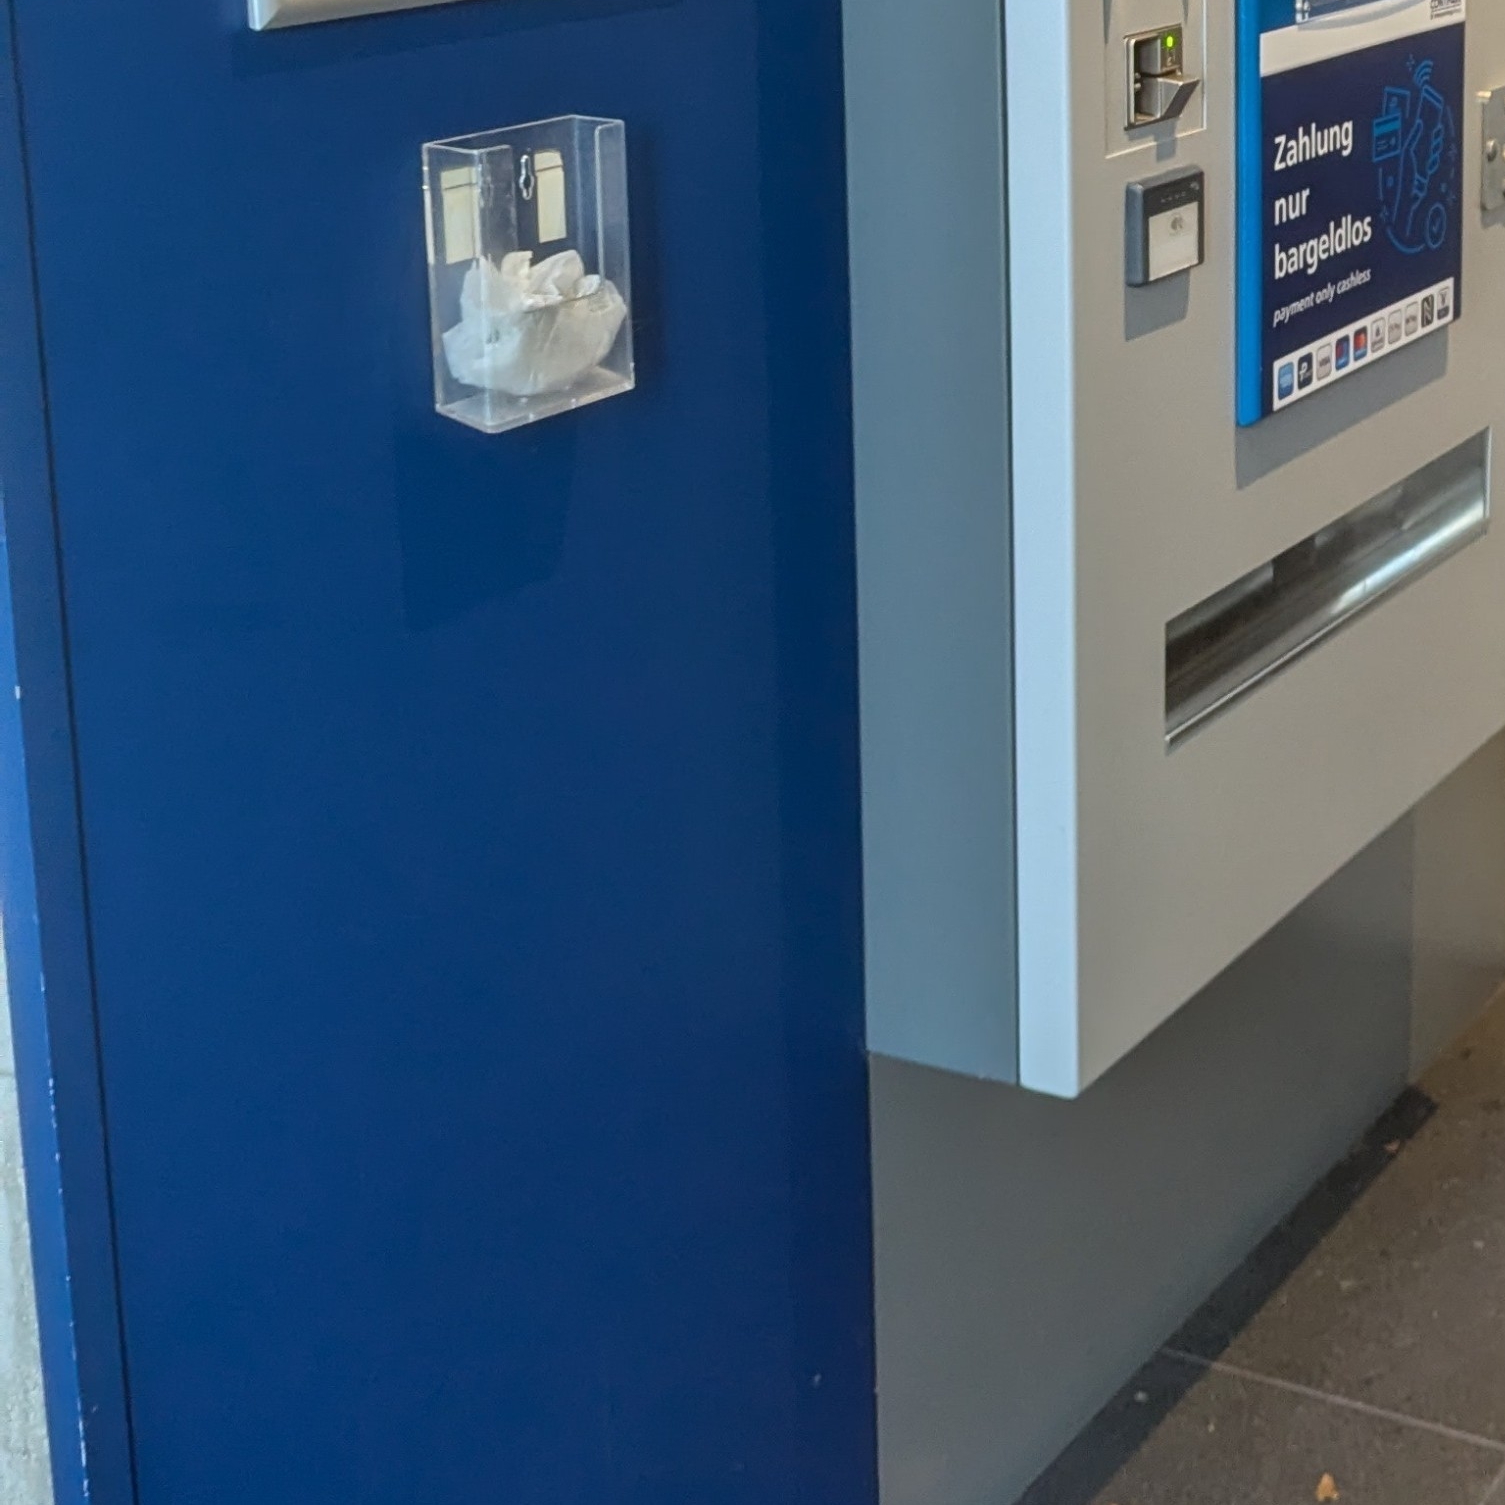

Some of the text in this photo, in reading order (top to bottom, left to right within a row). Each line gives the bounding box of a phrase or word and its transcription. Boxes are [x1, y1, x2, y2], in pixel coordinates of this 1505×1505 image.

[1274, 120, 1353, 171] Zahlung
[1274, 186, 1310, 226] nur
[1274, 214, 1372, 279] bargeldlos
[1273, 269, 1371, 328] payment only cashless
